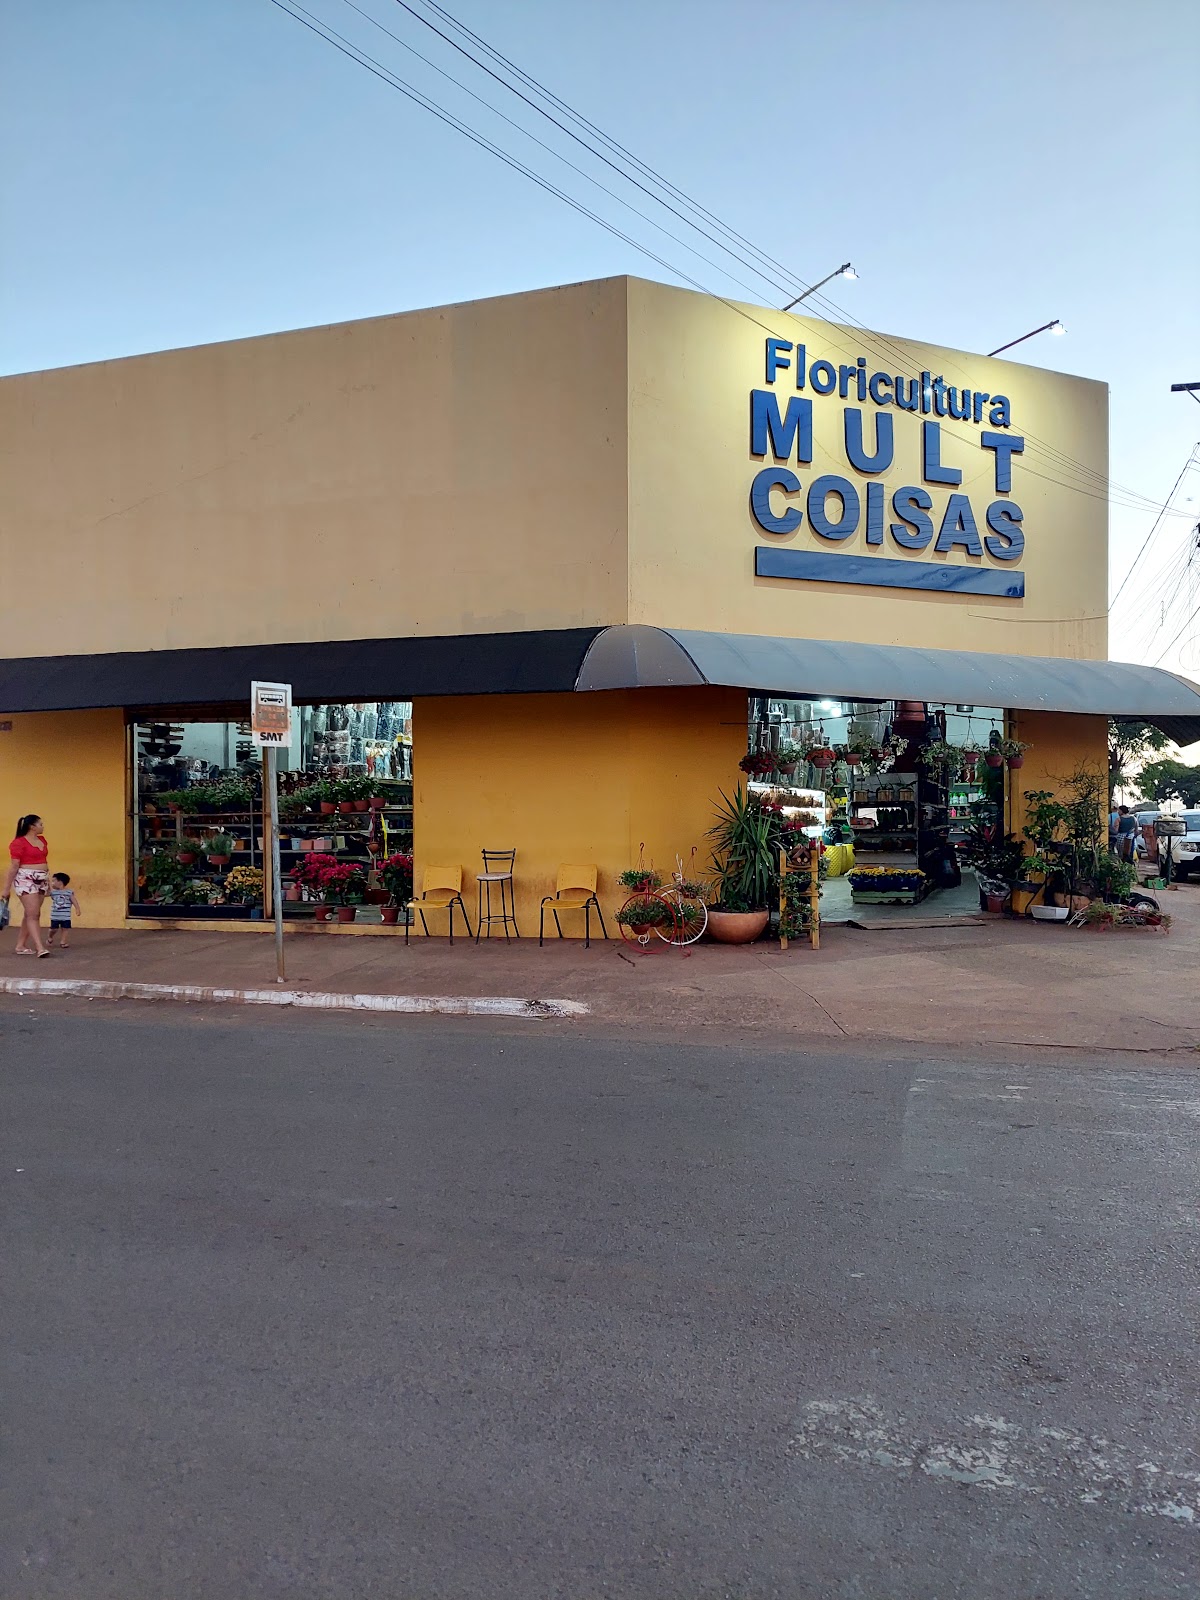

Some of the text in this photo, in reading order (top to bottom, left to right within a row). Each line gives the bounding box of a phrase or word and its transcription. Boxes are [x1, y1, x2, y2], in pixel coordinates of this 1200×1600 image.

[765, 337, 1011, 428] Floricultura
[750, 467, 1024, 561] COISAS
[260, 732, 283, 741] SMT
